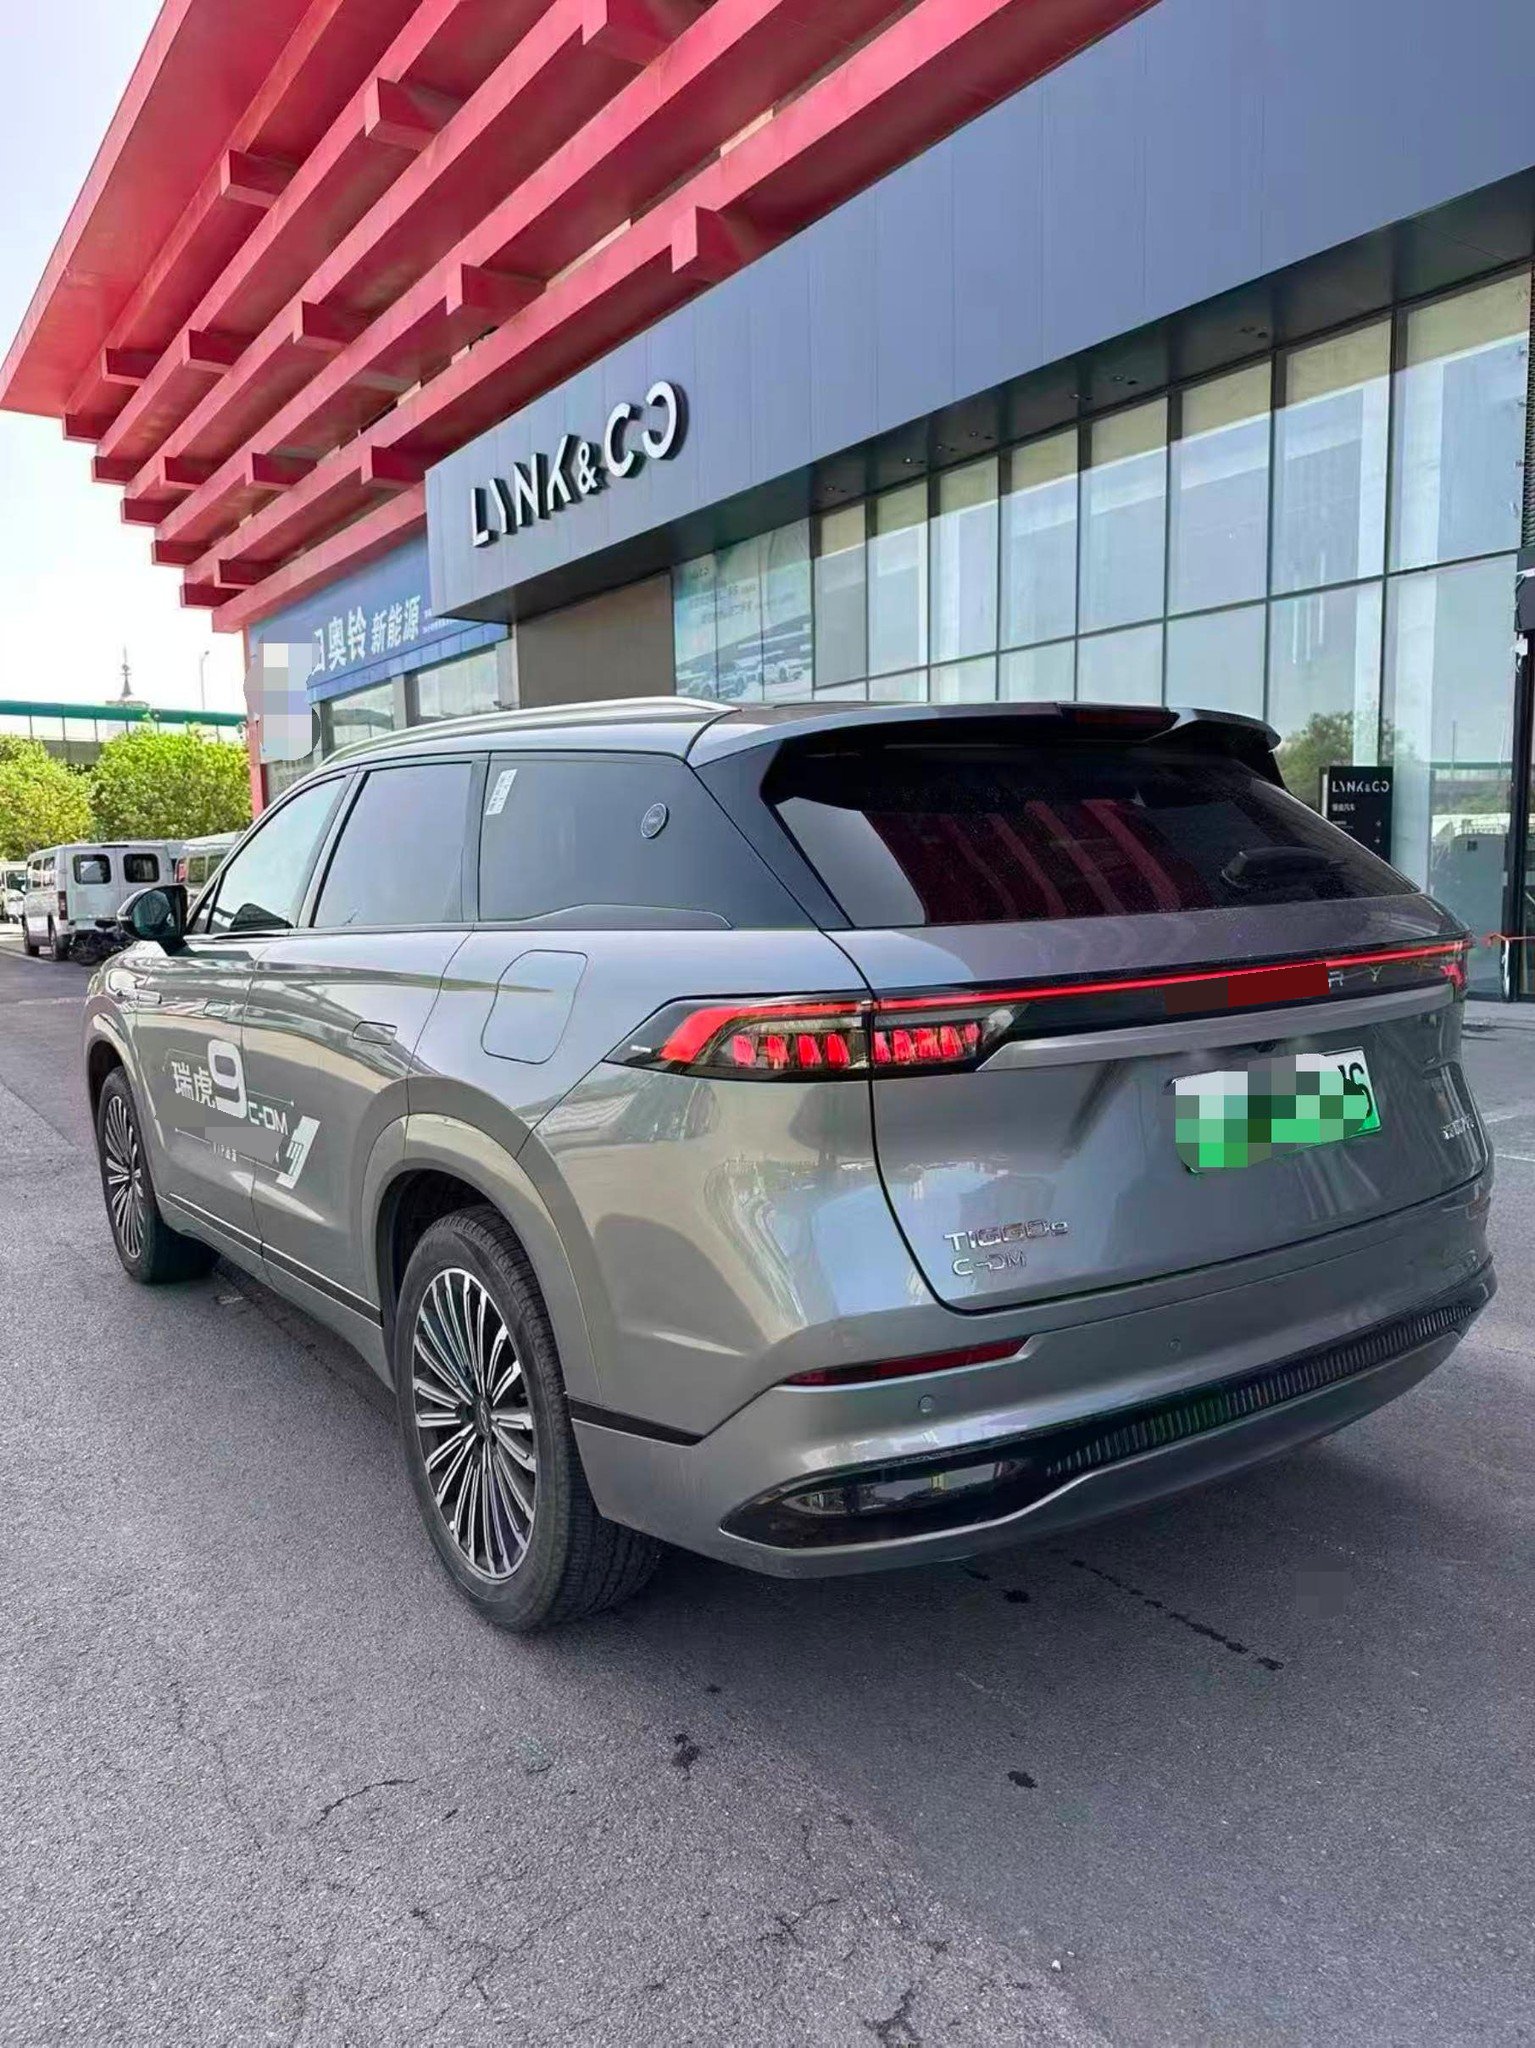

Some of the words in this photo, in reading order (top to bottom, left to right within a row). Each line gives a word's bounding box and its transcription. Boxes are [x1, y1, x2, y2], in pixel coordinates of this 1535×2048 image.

[371, 595, 421, 655] 新能源
[248, 1101, 289, 1135] C-DM
